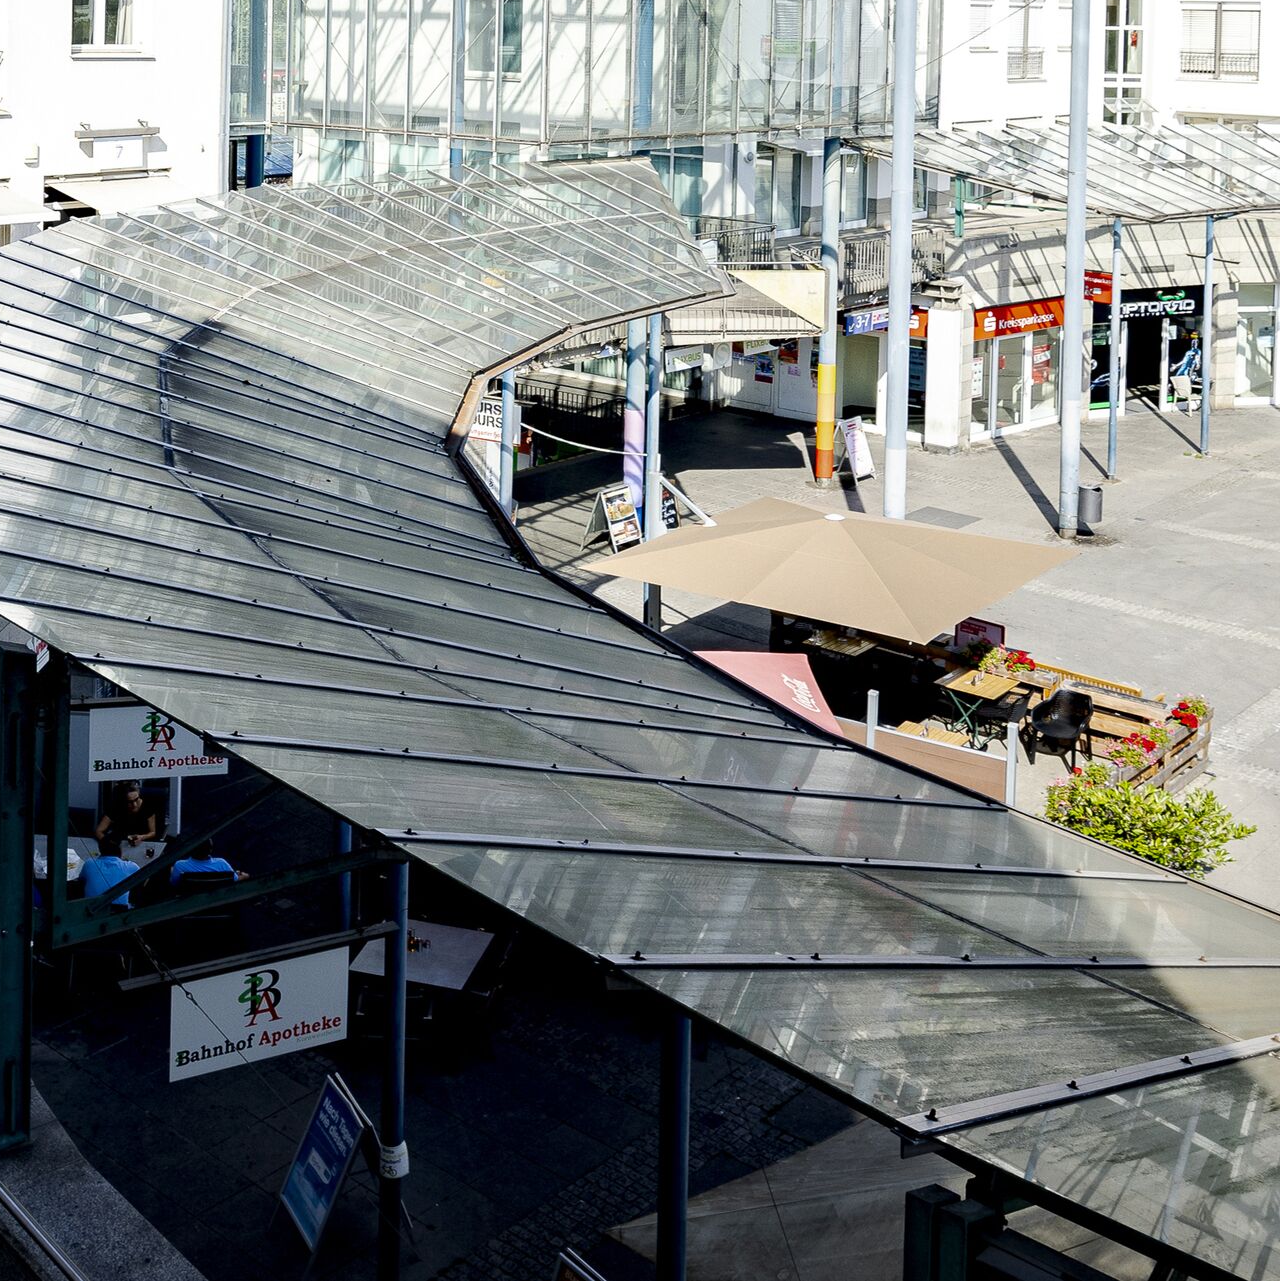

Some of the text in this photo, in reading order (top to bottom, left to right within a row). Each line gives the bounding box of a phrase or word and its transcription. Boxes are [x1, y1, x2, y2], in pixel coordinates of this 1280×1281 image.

[856, 313, 871, 329] 3-7
[998, 313, 1055, 330] Kreissparkasse
[780, 672, 821, 713] Coca-Cola
[93, 754, 224, 772] Bahnhof Apotheke
[176, 1015, 342, 1068] Bahnhof Apotheke
